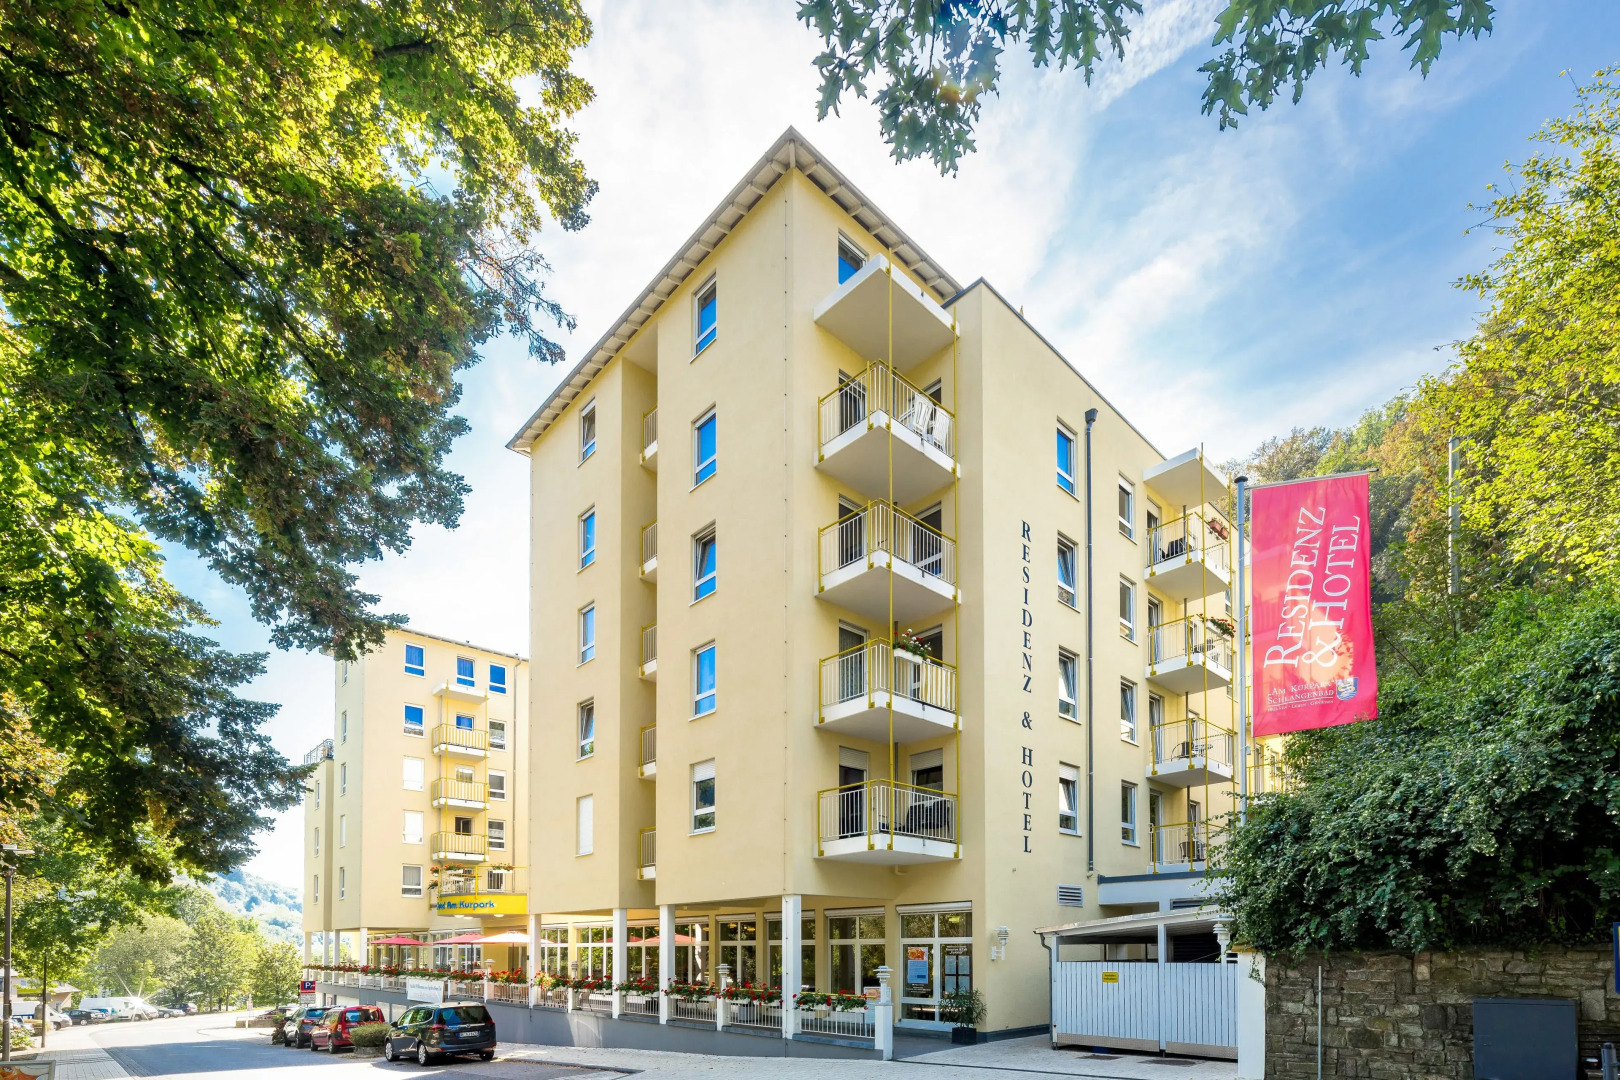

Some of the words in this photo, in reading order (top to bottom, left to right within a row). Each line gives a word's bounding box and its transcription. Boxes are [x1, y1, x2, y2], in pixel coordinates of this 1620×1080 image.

[1020, 519, 1034, 694] RESIDENZ
[1264, 506, 1326, 668] RESIDENZ
[1308, 515, 1361, 631] HOTEL
[1301, 633, 1342, 668] &
[1021, 711, 1033, 731] &
[1268, 690, 1334, 704] SCHLANGENBAD
[1020, 745, 1033, 854] HOTEL
[459, 900, 495, 910] Kurpark
